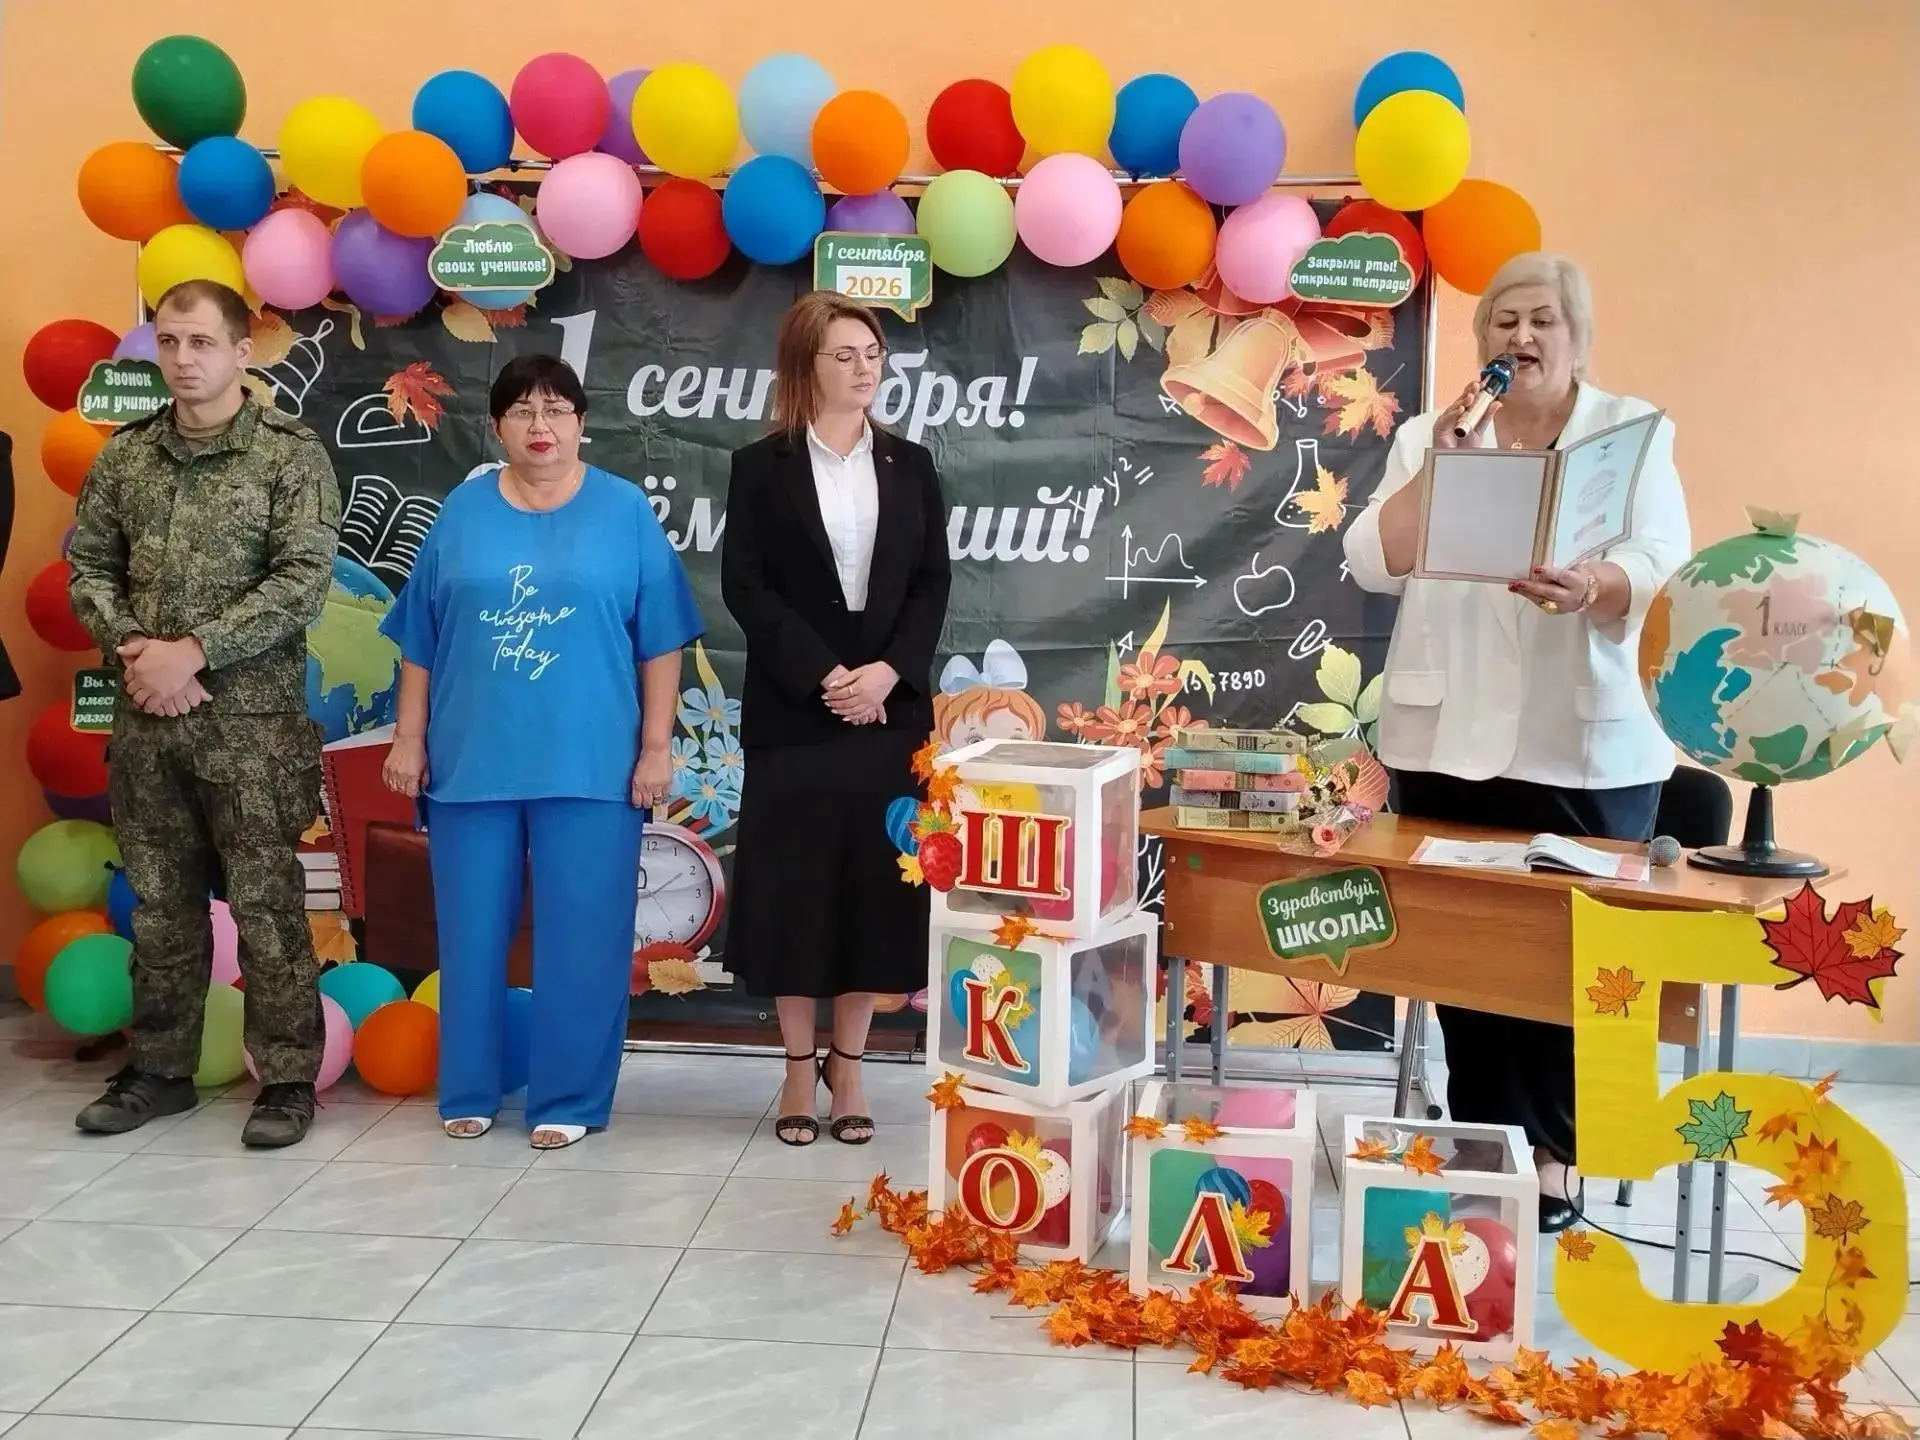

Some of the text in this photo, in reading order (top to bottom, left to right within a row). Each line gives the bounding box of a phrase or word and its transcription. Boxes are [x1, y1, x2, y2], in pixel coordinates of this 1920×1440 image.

[463, 239, 514, 254] Люблю
[827, 242, 926, 268] 1 сентября
[437, 258, 547, 275] своих учеников!
[1307, 256, 1398, 273] Закрыли рты!
[846, 275, 902, 297] 2026
[1290, 272, 1411, 293] Открыли тетради!
[104, 368, 152, 387] Звонок
[83, 394, 109, 413] для
[627, 349, 1038, 444] сенбря!
[505, 564, 539, 615] Be
[479, 606, 577, 633] awesome
[1756, 596, 1770, 636] 1
[82, 676, 104, 688] Вы
[75, 713, 114, 726] разго
[646, 841, 658, 851] 12
[673, 848, 678, 856] 1
[955, 810, 1072, 900] Ш
[690, 866, 696, 875] 2
[695, 889, 702, 899] 3
[1267, 878, 1379, 920] Здравствуй,
[688, 915, 695, 924] 4
[1276, 906, 1386, 950] ШКОЛА!
[645, 935, 652, 944] 6
[668, 931, 674, 940] 5
[962, 977, 1031, 1072] К
[958, 1148, 1046, 1234] О
[1161, 1192, 1255, 1282] Л
[1388, 1235, 1479, 1333] А
